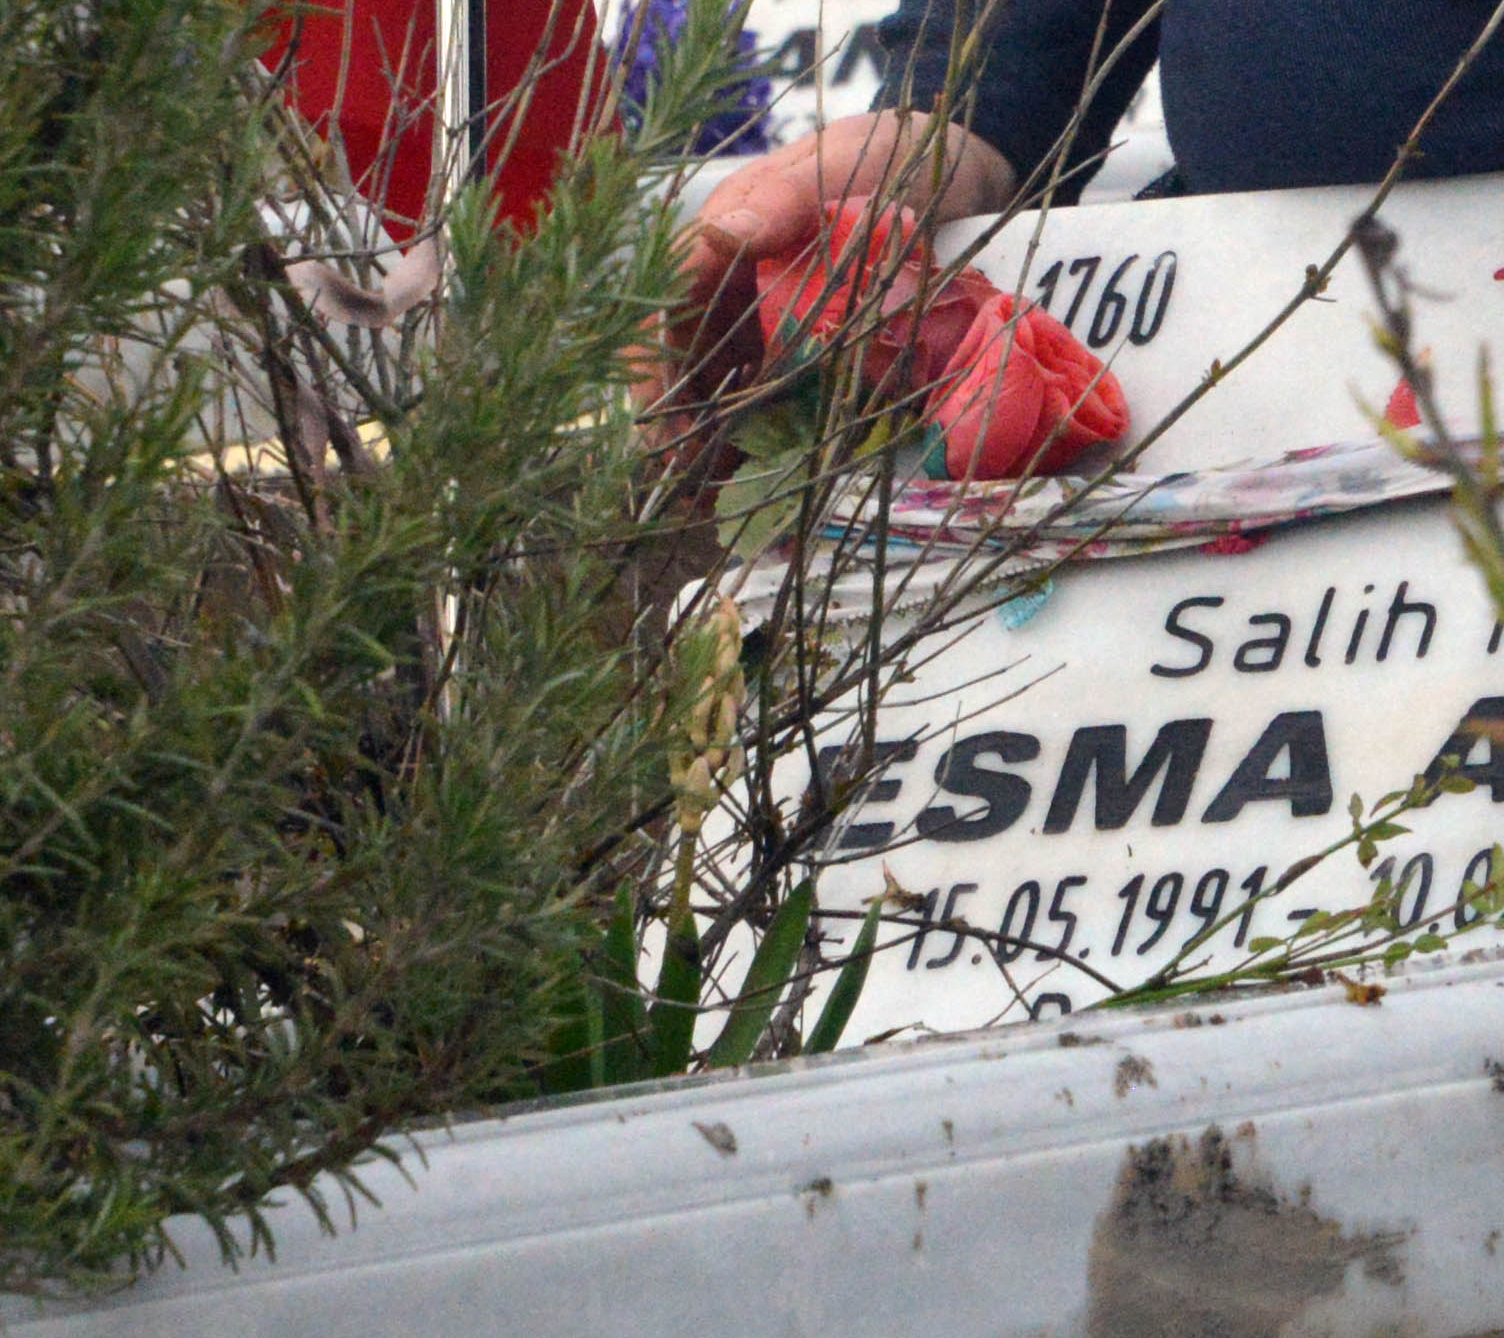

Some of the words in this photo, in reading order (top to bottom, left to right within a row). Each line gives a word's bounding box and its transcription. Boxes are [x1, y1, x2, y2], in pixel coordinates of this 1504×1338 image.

[1036, 249, 1178, 349] 1760
[1150, 579, 1438, 679] Salih
[796, 709, 1335, 851] ESMA
